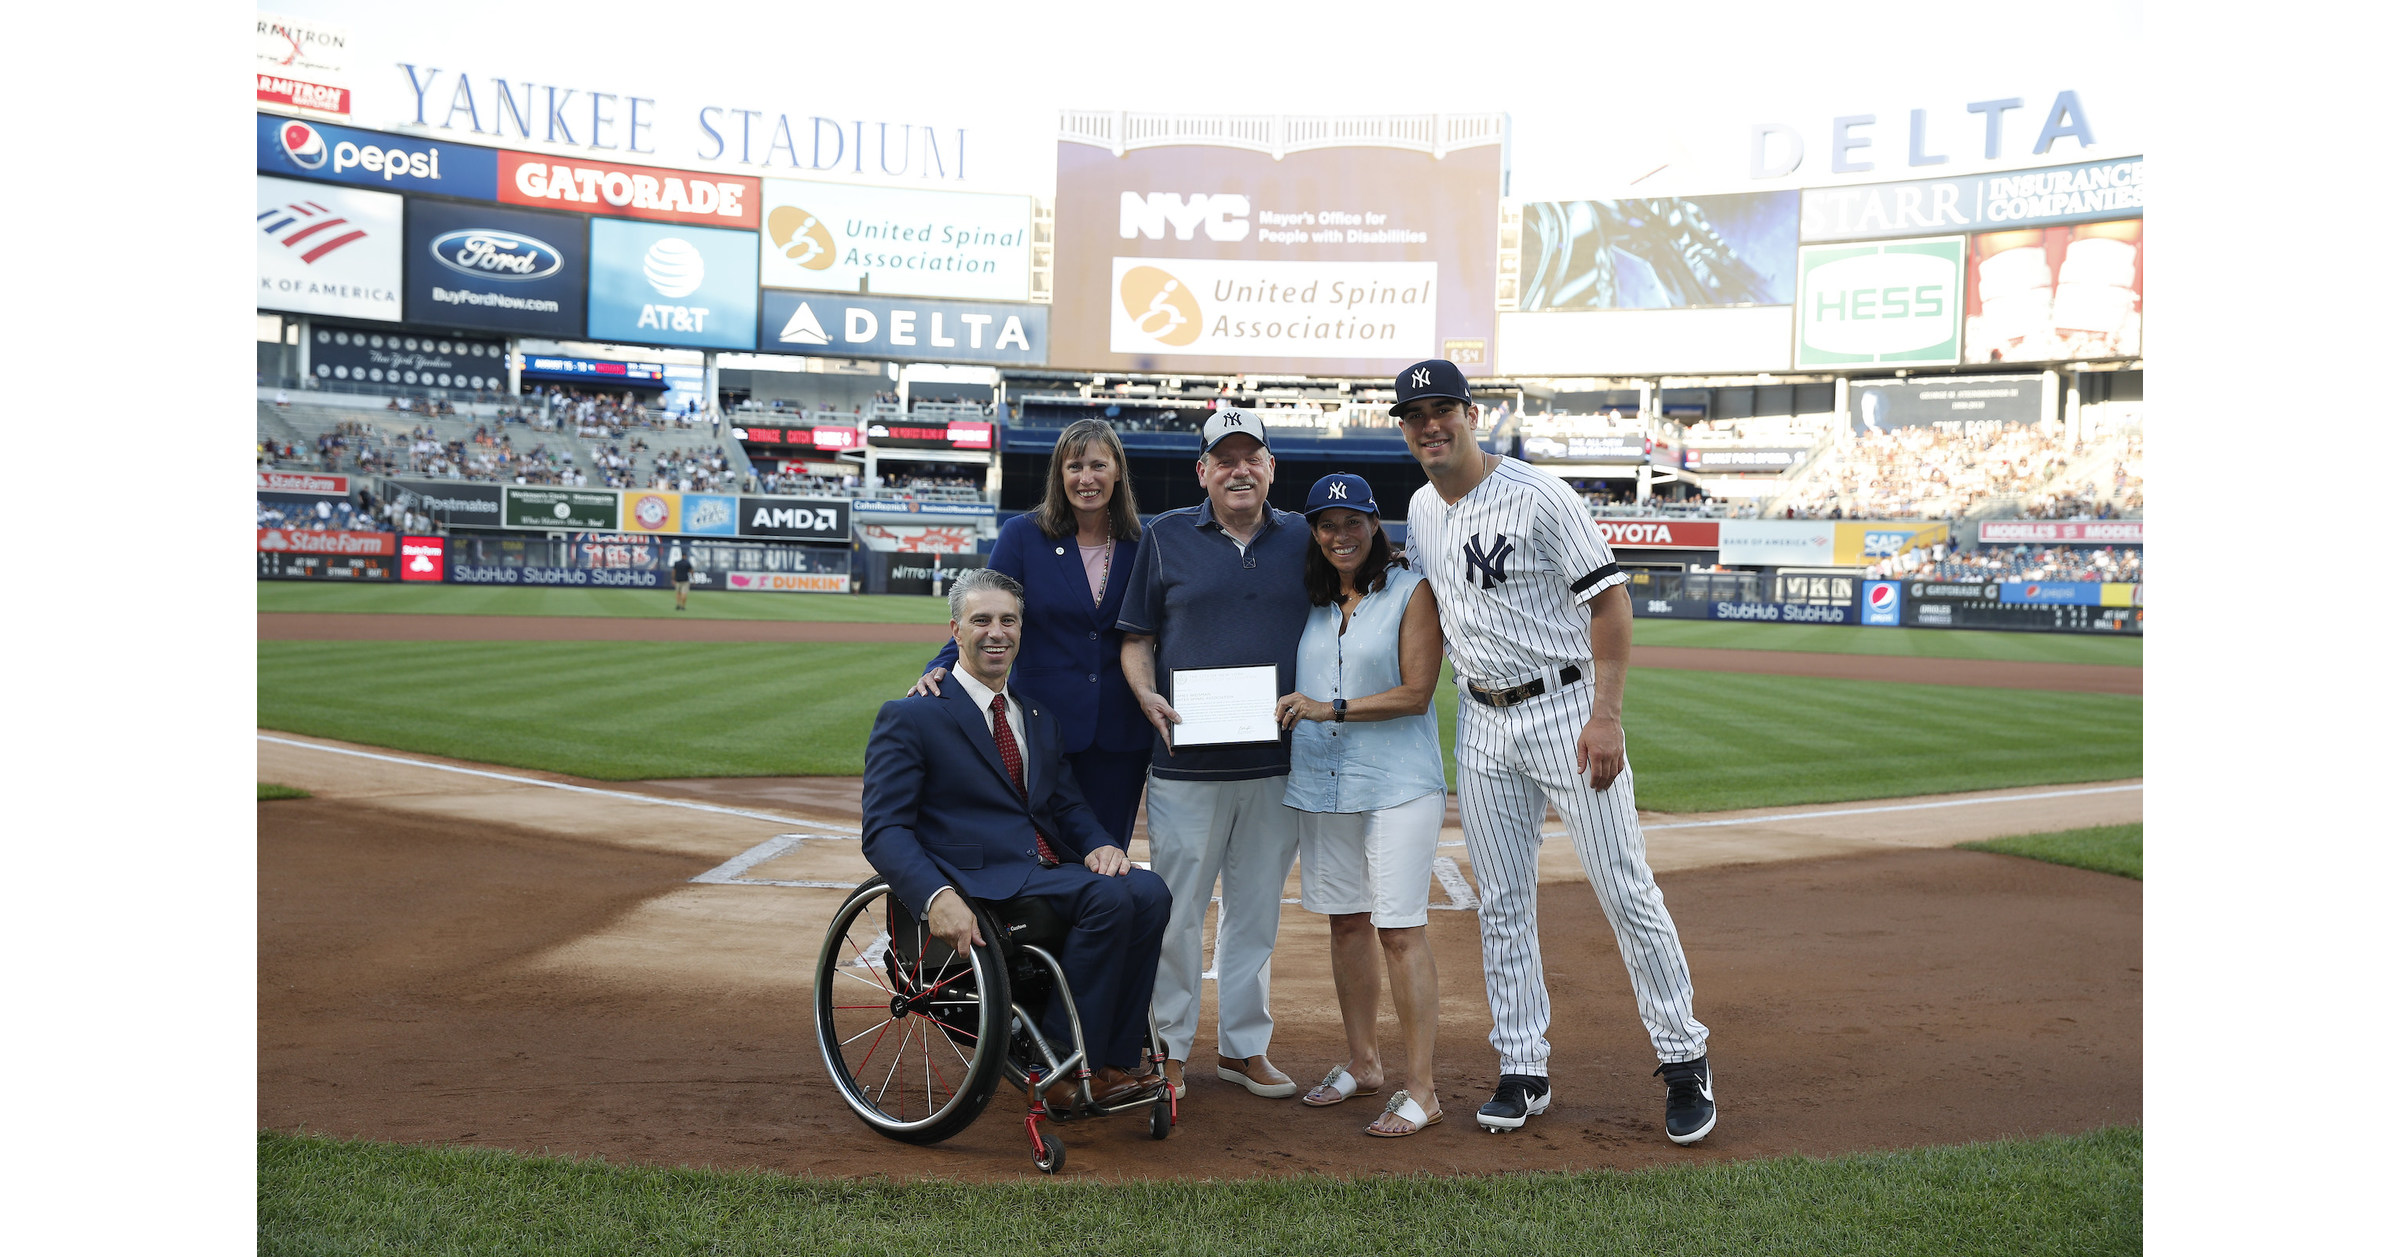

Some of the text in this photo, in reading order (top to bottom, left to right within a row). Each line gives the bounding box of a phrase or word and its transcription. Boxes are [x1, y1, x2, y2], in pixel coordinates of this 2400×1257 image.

[257, 21, 345, 48] RMITRON
[397, 63, 968, 181] YANKEE STADIUM
[1749, 90, 2096, 180] DELTA
[334, 141, 440, 181] pepsi
[515, 163, 745, 217] GATORADE
[1120, 191, 1250, 242] NYC
[1259, 211, 1387, 227] Mayor's Office for
[1801, 183, 1970, 236] STARR
[845, 219, 1023, 250] United Spinal
[1259, 229, 1427, 244] People with Disabilities
[456, 236, 539, 275] Ford
[844, 248, 996, 274] Association
[280, 278, 302, 292] OF
[309, 283, 396, 303] AMERICA
[432, 287, 558, 313] BuyFordNow.com
[1213, 279, 1431, 310] United Spinal
[1816, 284, 1943, 322] HESS
[637, 304, 710, 332] AT&T
[845, 307, 1030, 351] DELTA
[1212, 315, 1396, 339] Association
[1411, 367, 1431, 389] NY
[1223, 412, 1242, 428] NY
[1328, 481, 1347, 500] NY
[422, 496, 498, 513] Postmates
[752, 508, 815, 529] AMD
[1601, 524, 1672, 543] OYOTA
[1724, 537, 1807, 546] BANK OF AMERICA
[1865, 534, 1904, 553] SAP
[1463, 532, 1514, 589] NY
[454, 565, 656, 586] StubHub StubHub StubHub
[2040, 586, 2074, 599] pepsi
[1717, 602, 1844, 623] StubHub StubHub
